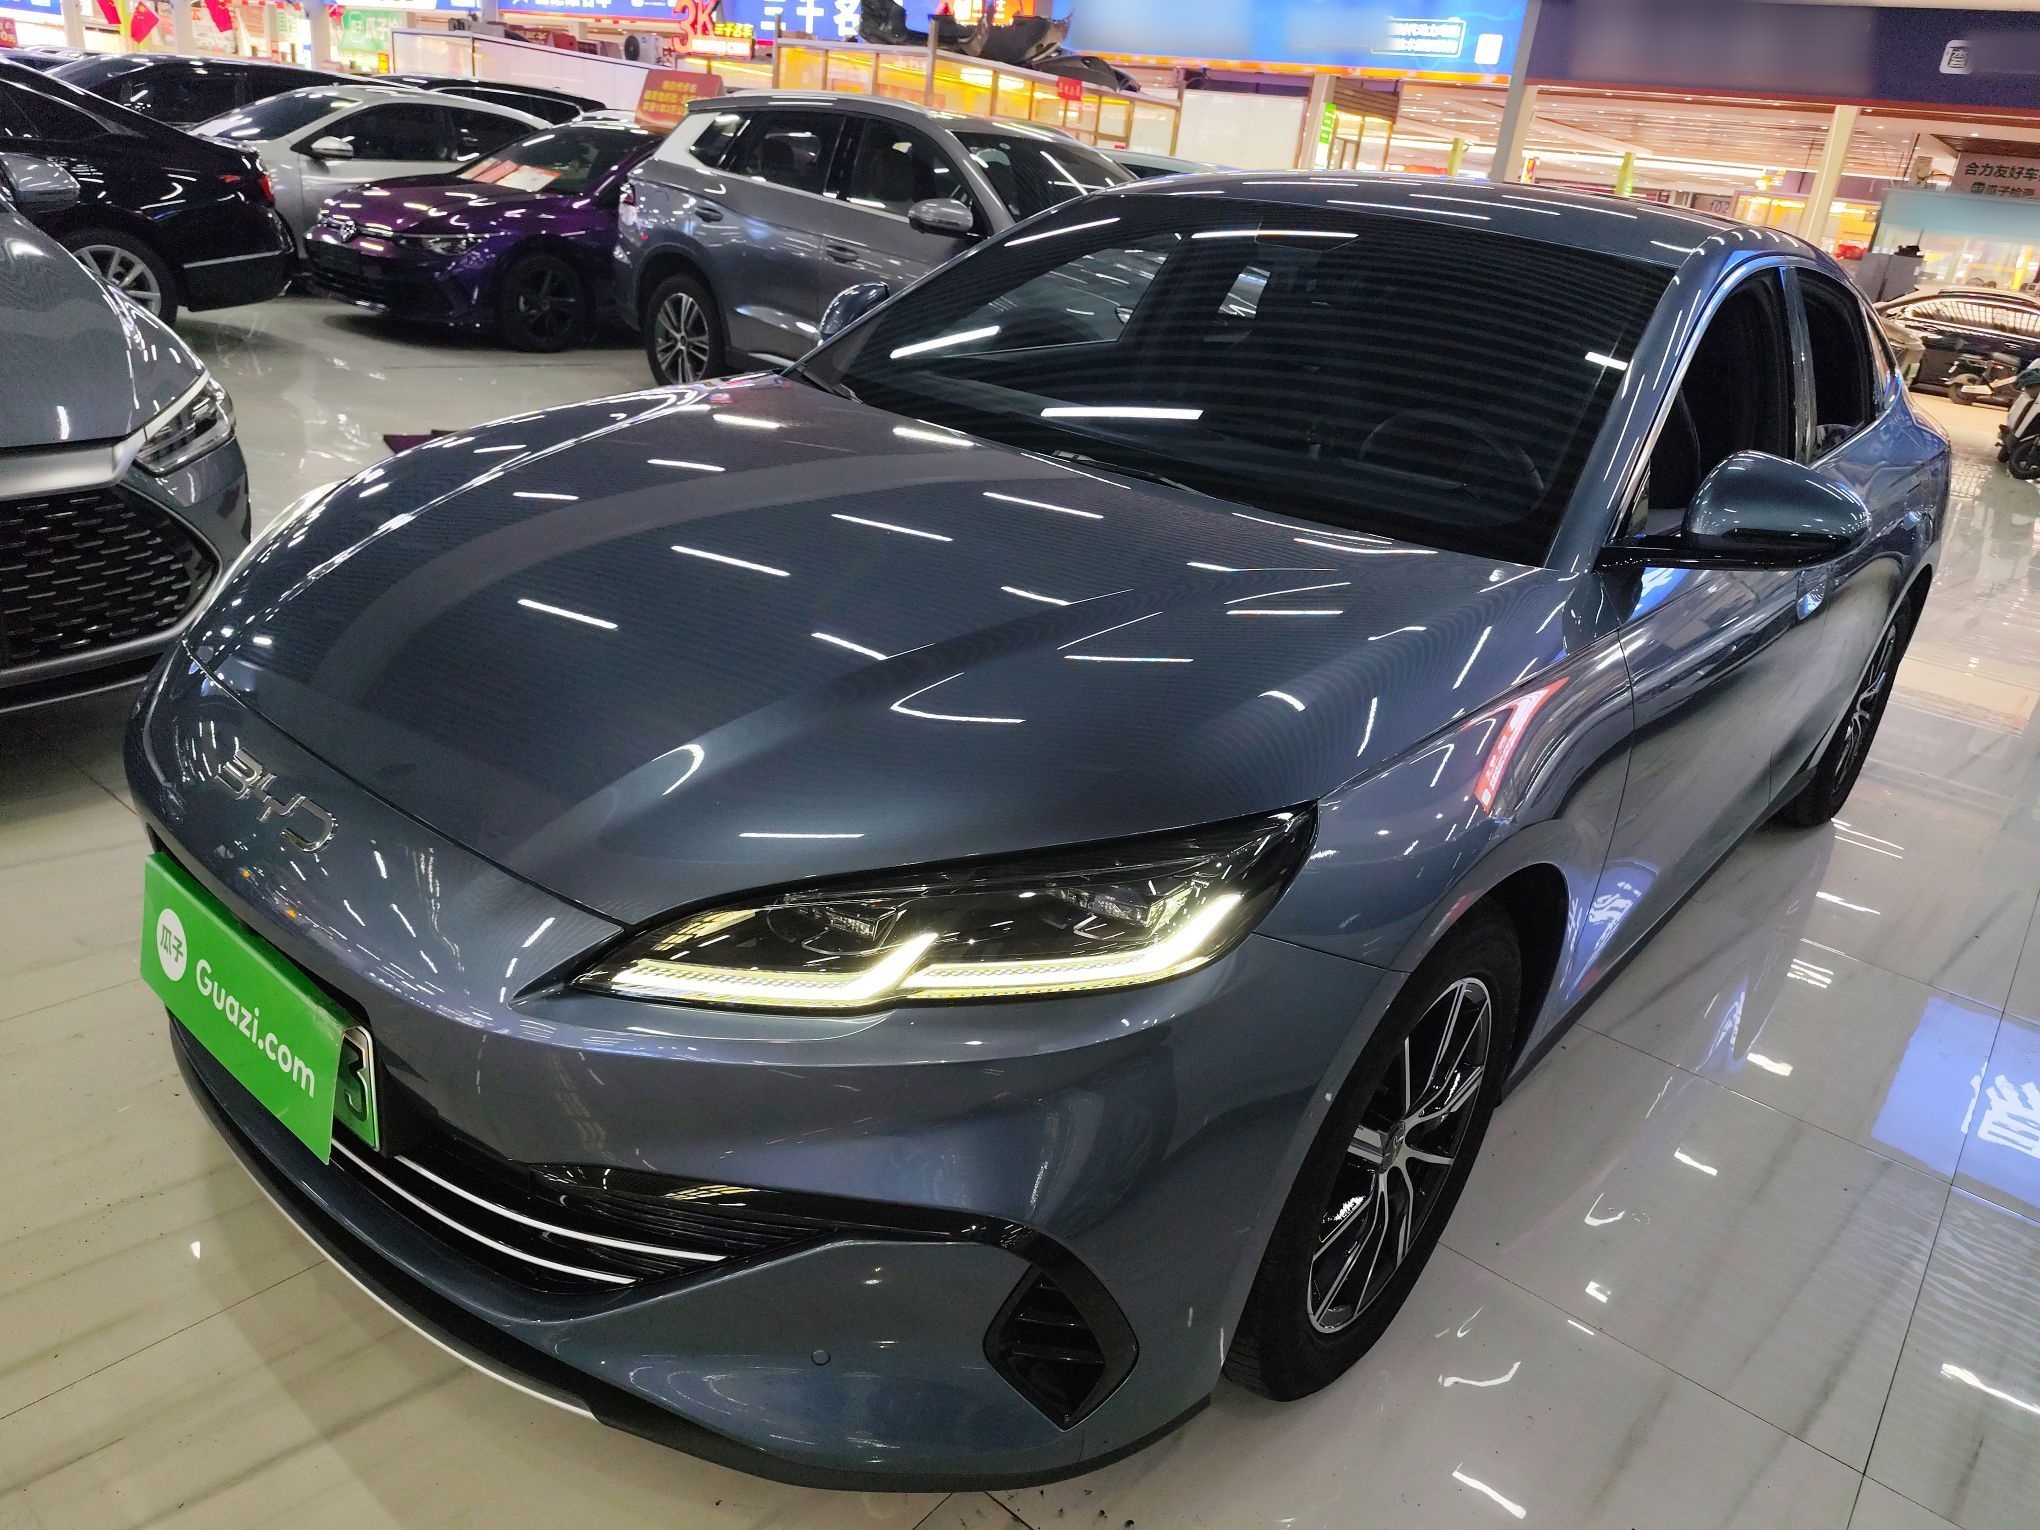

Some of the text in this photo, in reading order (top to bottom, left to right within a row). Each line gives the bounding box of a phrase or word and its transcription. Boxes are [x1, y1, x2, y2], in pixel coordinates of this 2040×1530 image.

[671, 0, 720, 54] 3K
[1964, 161, 2040, 182] 合力友好车
[214, 747, 339, 853] BYD
[159, 923, 186, 964] 瓜子
[195, 959, 316, 1098] Guazi.com
